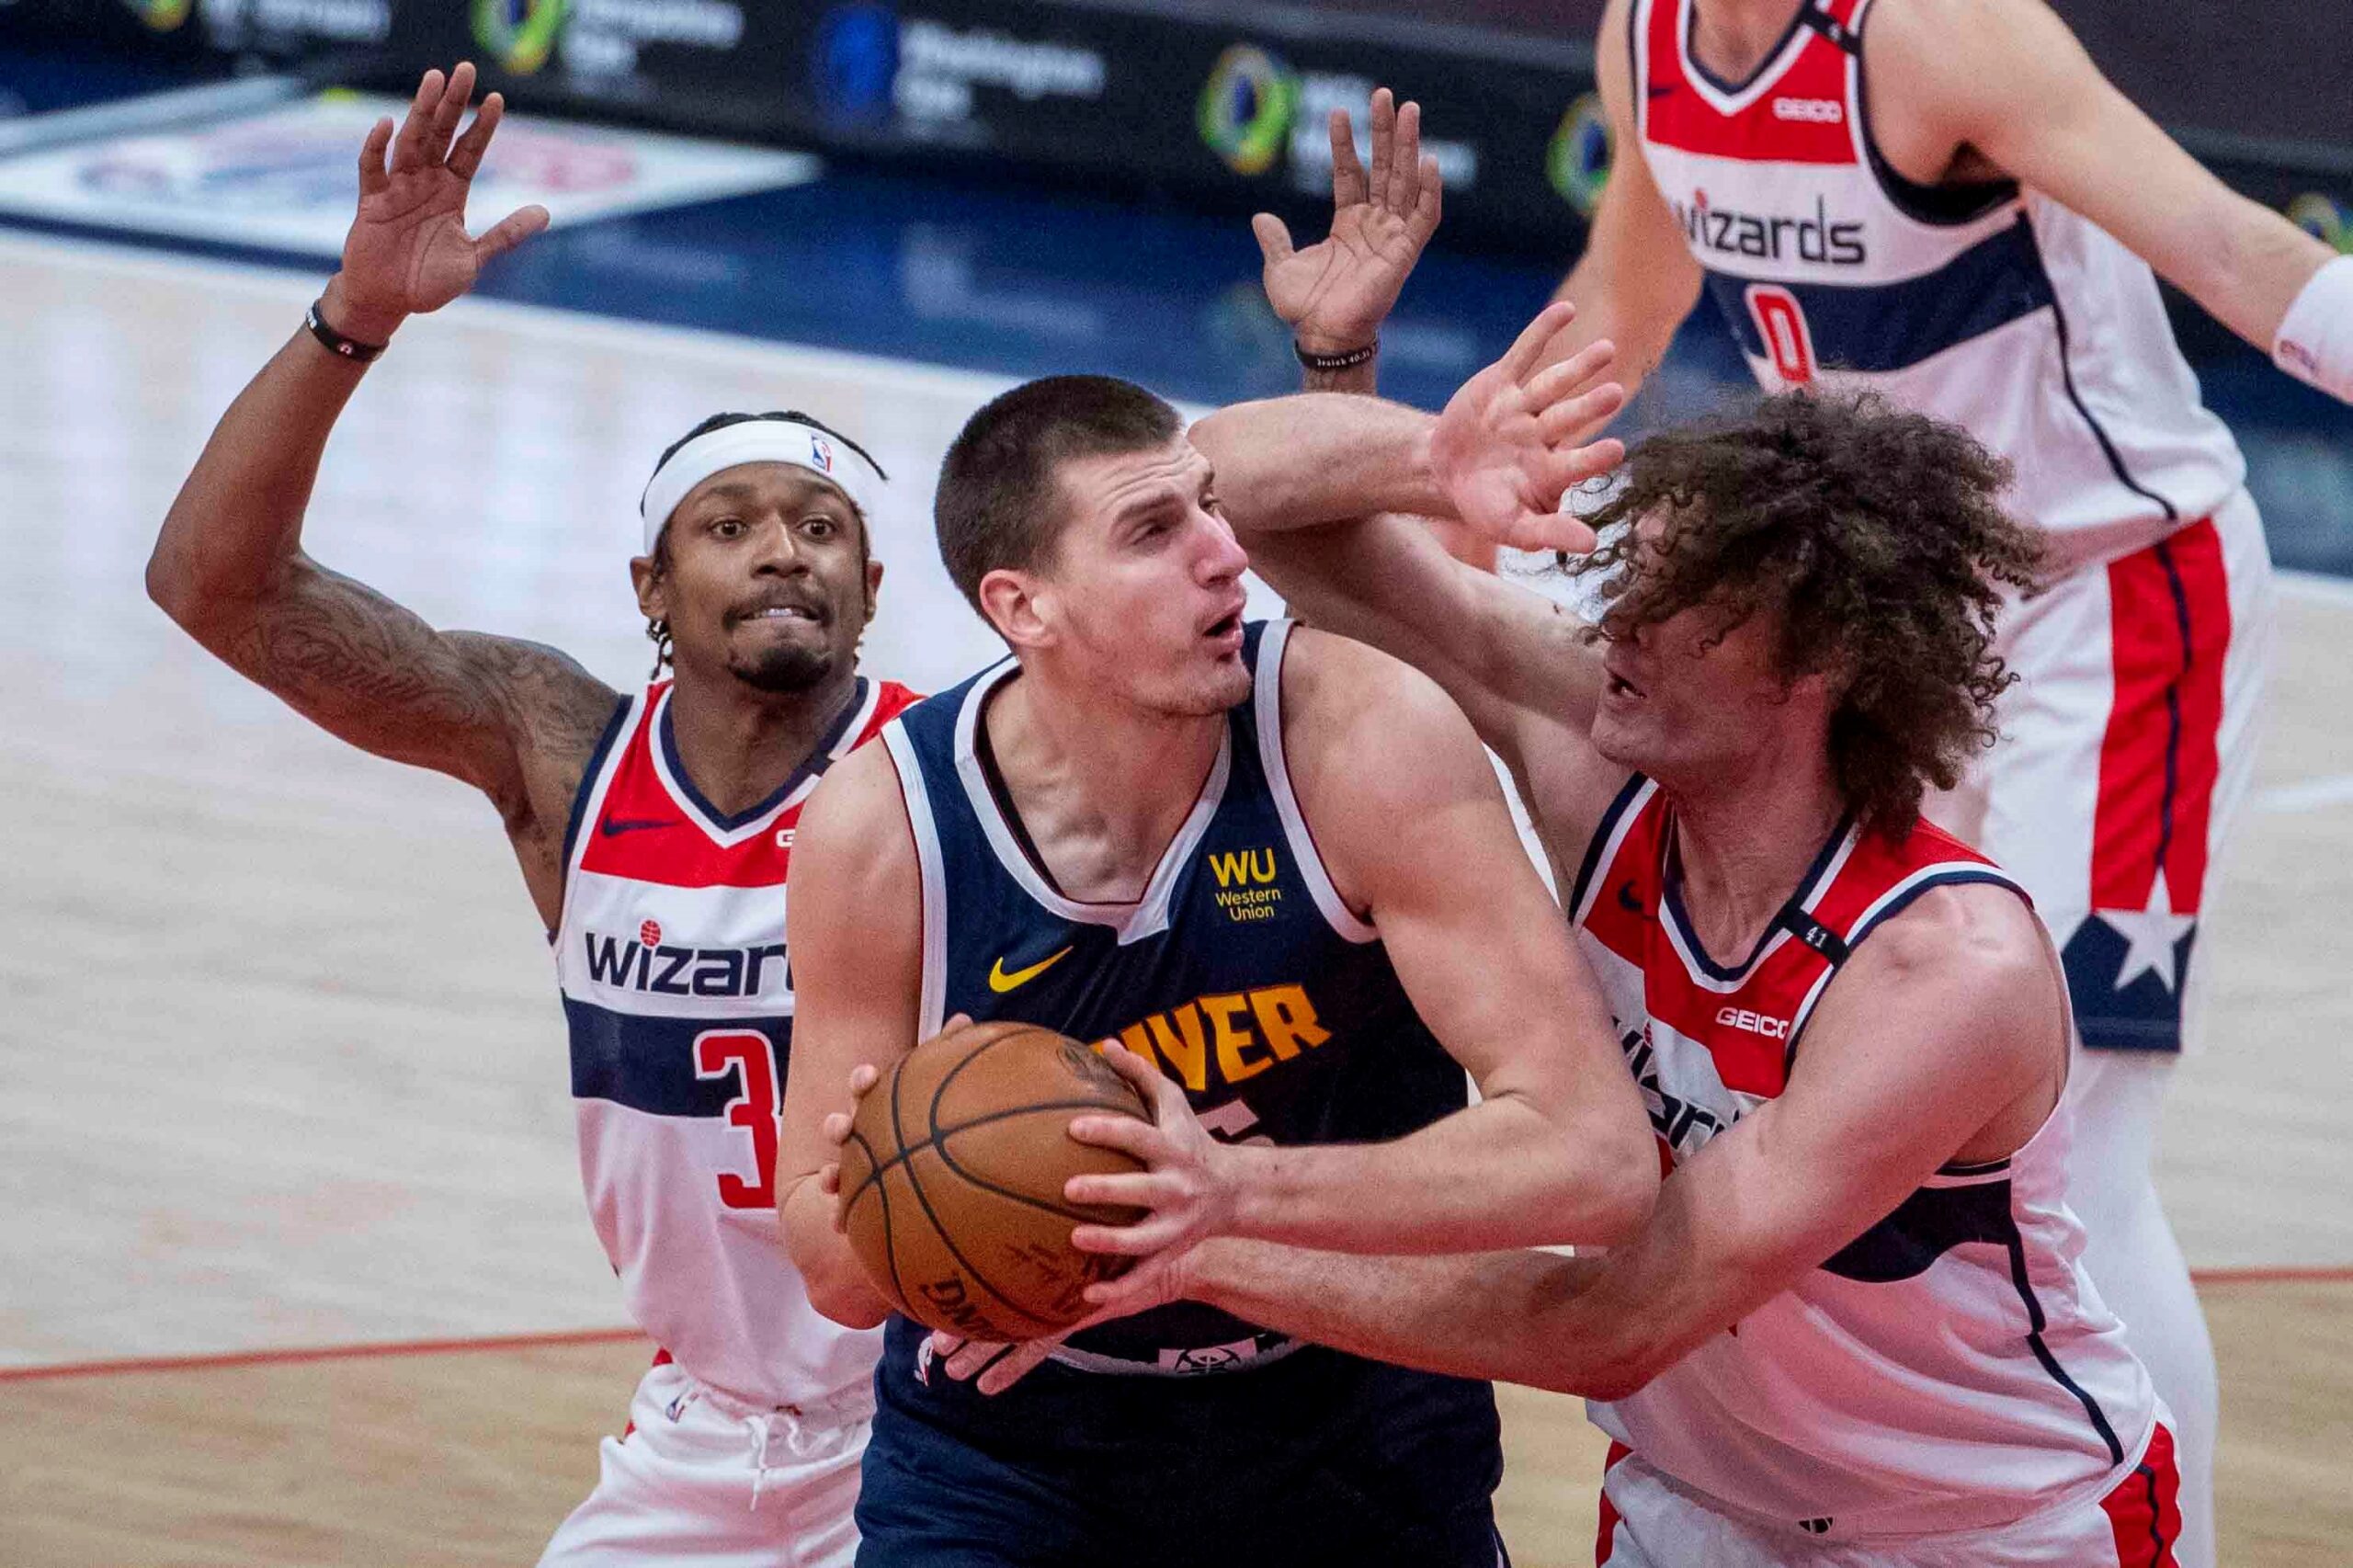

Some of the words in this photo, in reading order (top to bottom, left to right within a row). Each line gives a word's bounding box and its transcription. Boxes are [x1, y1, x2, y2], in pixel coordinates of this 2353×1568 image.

[1745, 284, 1819, 386] 0
[1209, 847, 1276, 887] WU
[1215, 888, 1281, 907] Western
[1230, 904, 1274, 921] Union
[585, 920, 793, 997] wizar
[1804, 926, 1827, 949] 41
[1087, 983, 1333, 1092] VER
[693, 1028, 782, 1210] 3
